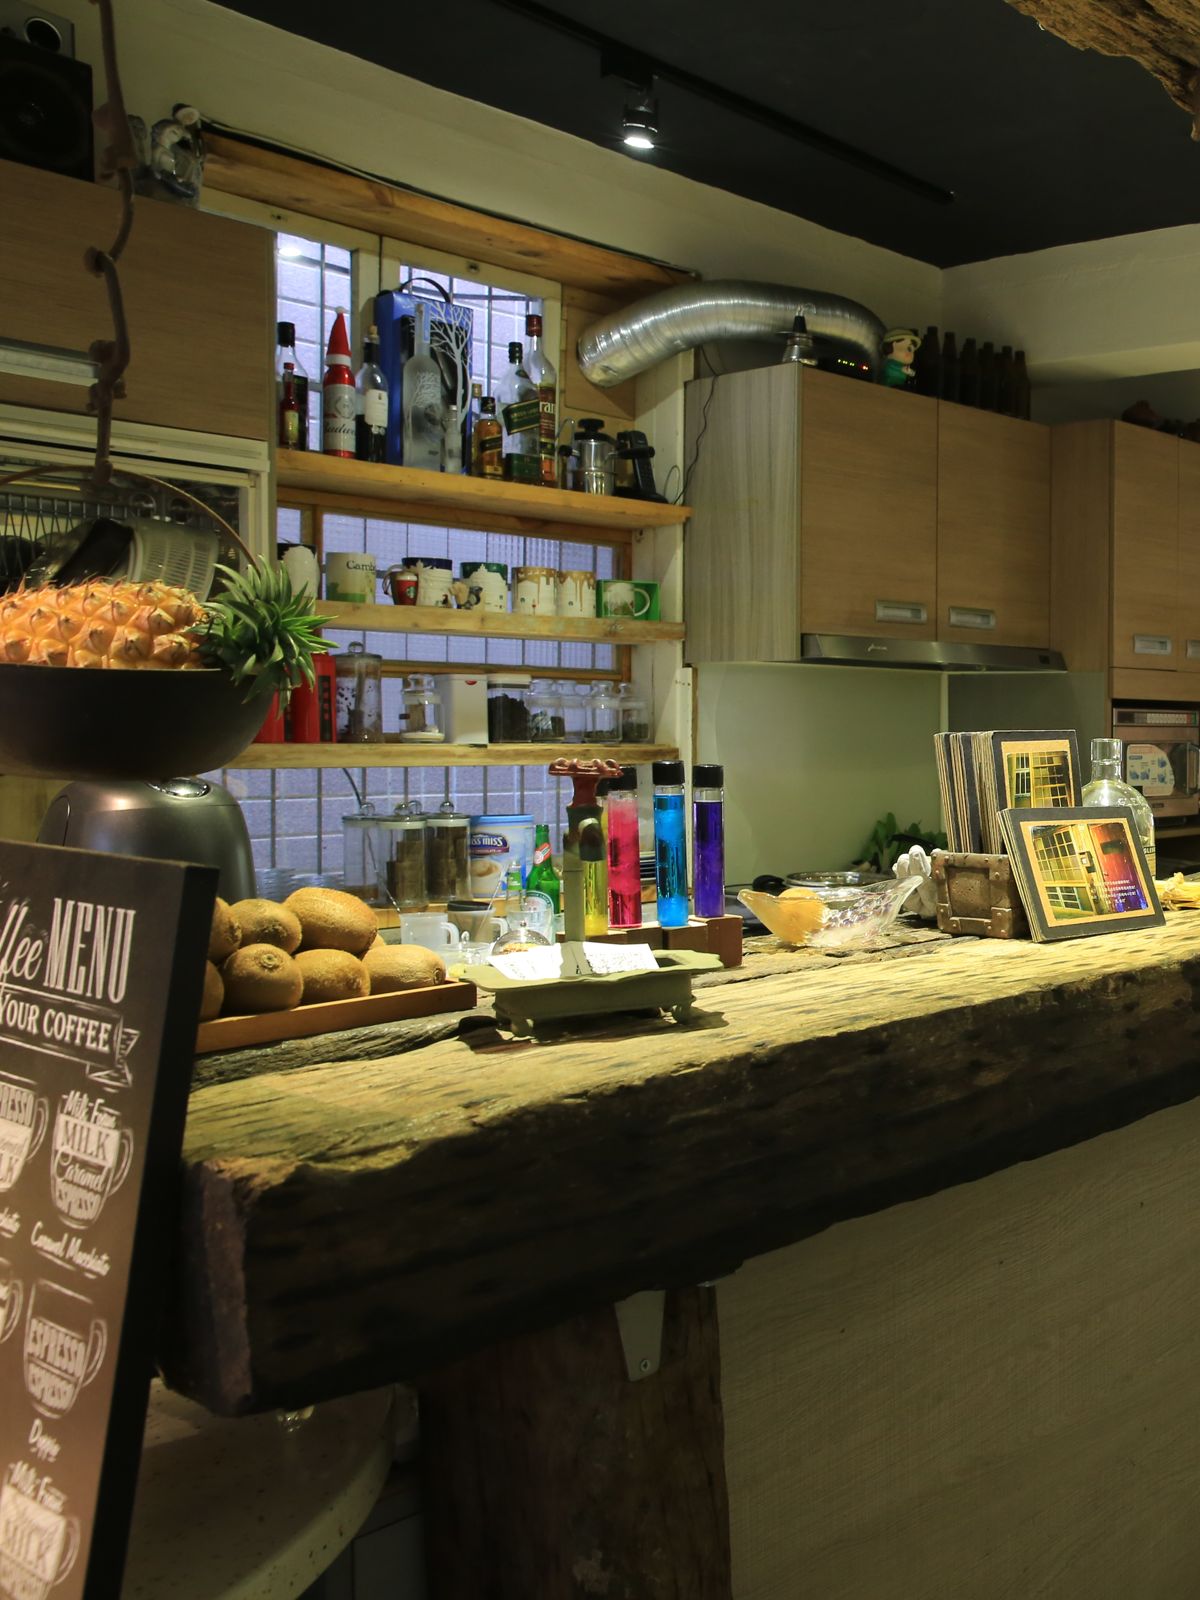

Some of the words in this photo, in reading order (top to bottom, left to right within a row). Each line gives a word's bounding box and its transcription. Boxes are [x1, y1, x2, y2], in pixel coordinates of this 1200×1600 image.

[42, 897, 136, 1003] MENU
[43, 1009, 112, 1054] COFFEE
[61, 1120, 111, 1161] MILK
[29, 1317, 87, 1377] ESPRESSO
